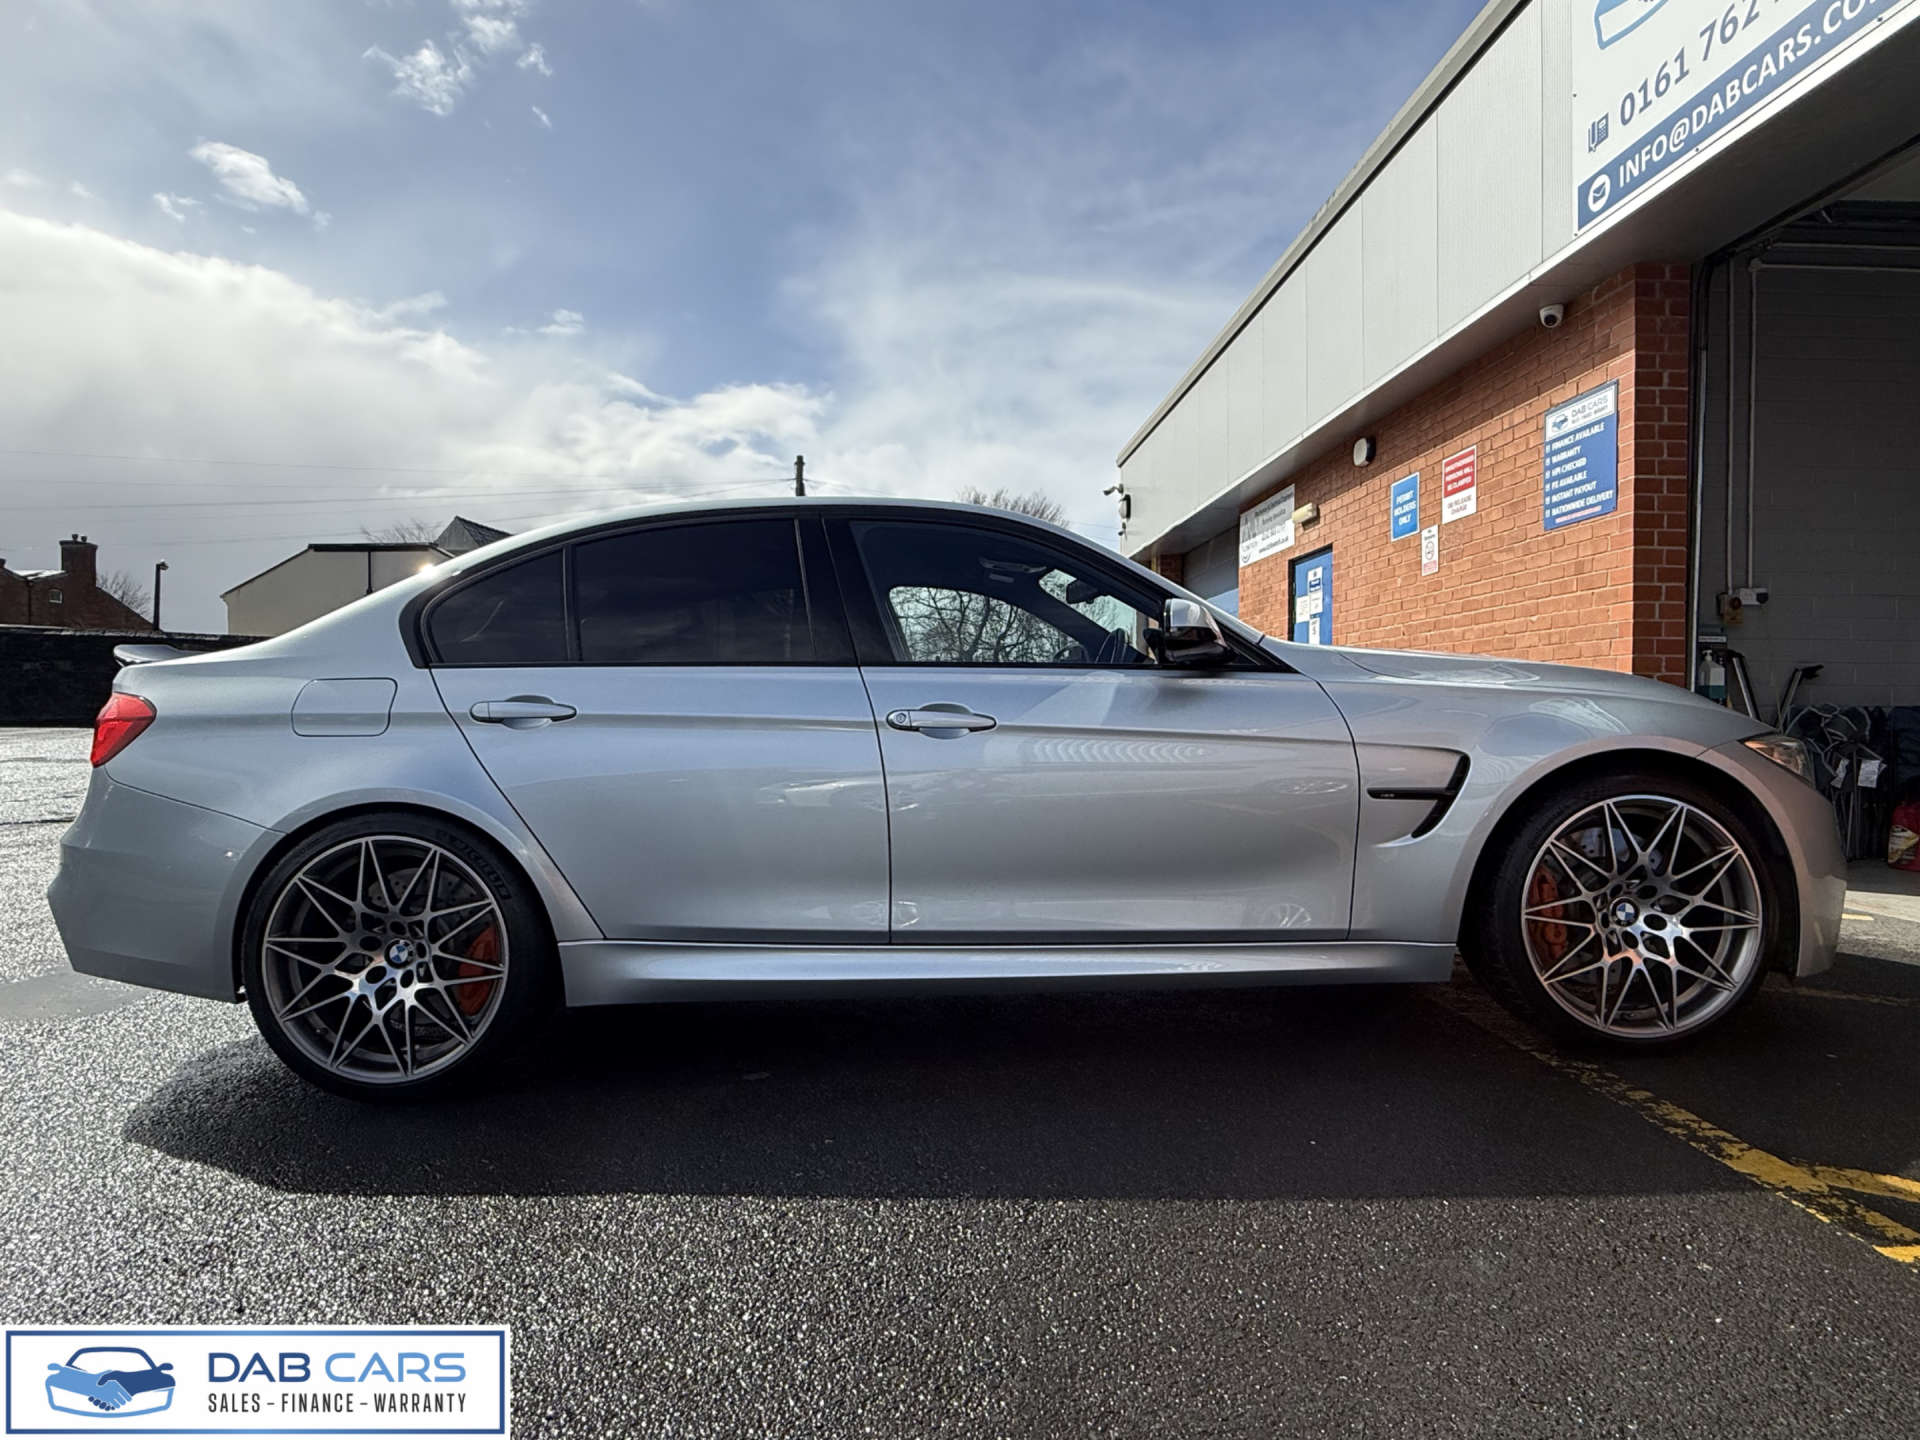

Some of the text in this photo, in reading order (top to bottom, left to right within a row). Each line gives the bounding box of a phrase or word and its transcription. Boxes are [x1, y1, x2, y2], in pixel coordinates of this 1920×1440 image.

[1620, 0, 1760, 126] 0161 762
[1587, 397, 1609, 413] CARS
[1575, 422, 1605, 442] AVAILABLE
[1551, 445, 1582, 464] WARRANTY
[1560, 470, 1587, 488] AVAILABLE
[1586, 489, 1614, 506] DELIVERY
[1394, 501, 1416, 516] HOLDERS
[1398, 514, 1412, 526] ONLY
